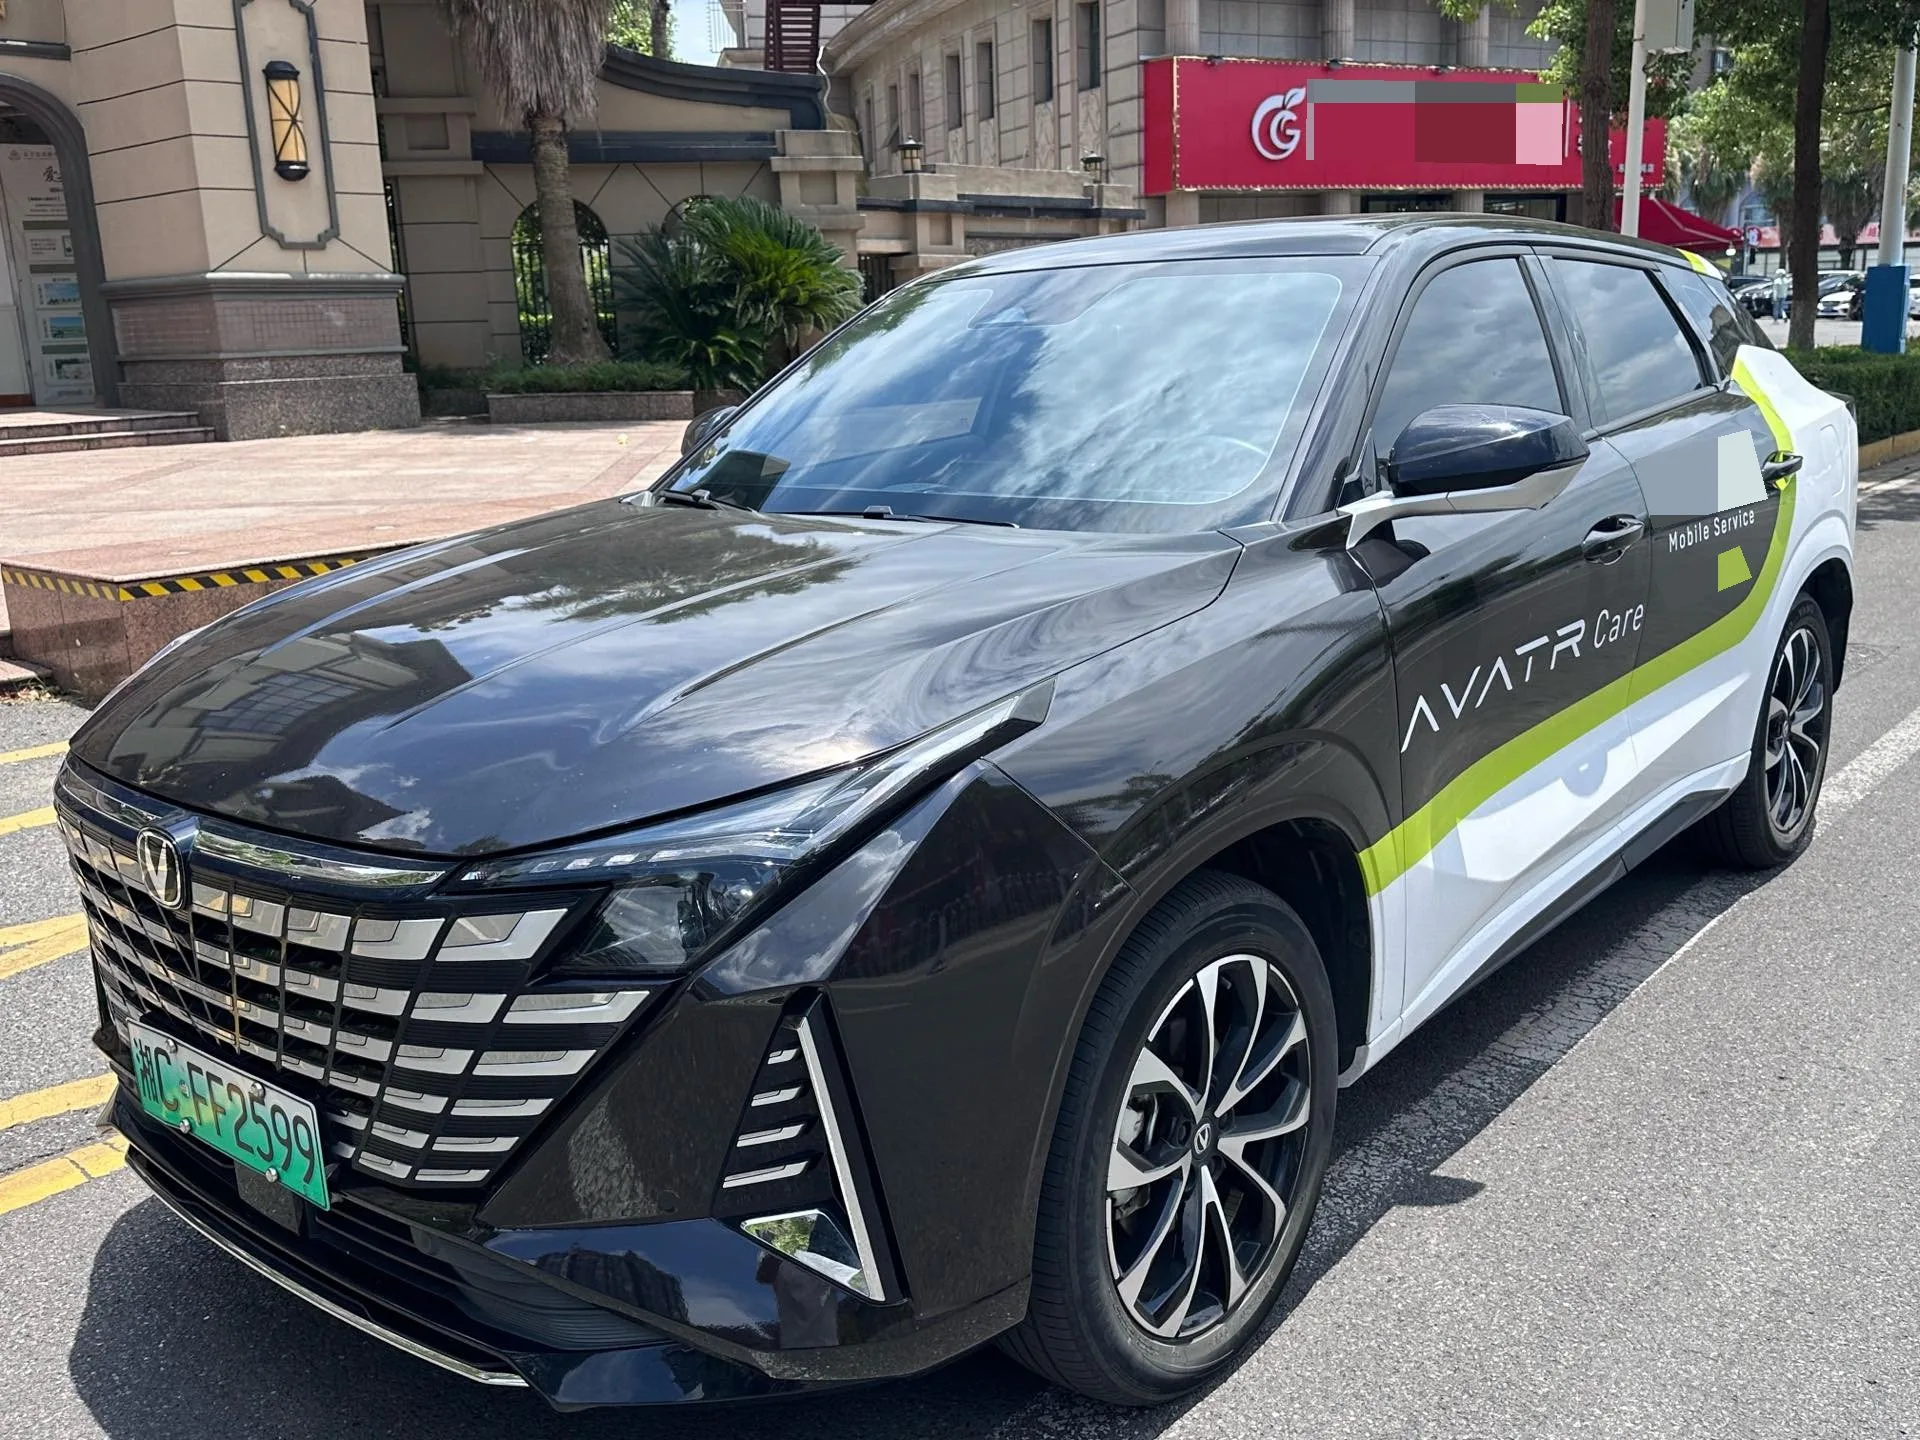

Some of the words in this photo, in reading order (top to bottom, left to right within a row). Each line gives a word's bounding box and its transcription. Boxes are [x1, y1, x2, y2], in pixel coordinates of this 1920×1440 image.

[1668, 521, 1710, 553] Mobile
[1713, 509, 1755, 537] Service
[1400, 618, 1586, 754] AVATR
[1593, 603, 1644, 649] Care
